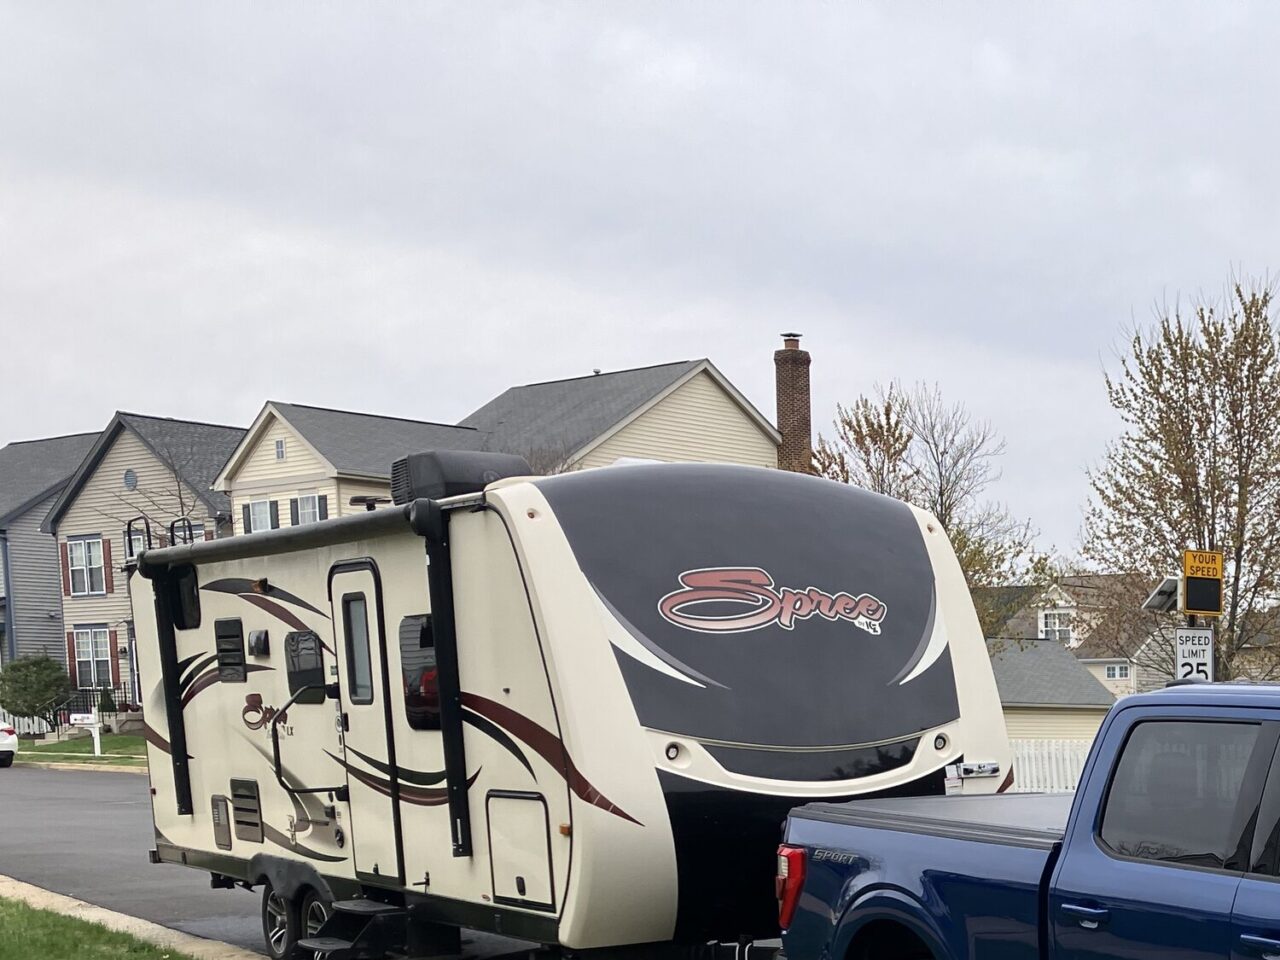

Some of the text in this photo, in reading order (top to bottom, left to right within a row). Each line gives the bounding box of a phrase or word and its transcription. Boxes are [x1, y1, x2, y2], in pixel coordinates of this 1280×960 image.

[1192, 554, 1217, 565] YOUR
[1190, 566, 1218, 577] SPEED
[658, 567, 887, 634] Spree
[1179, 635, 1210, 646] SPEED
[1182, 649, 1207, 659] LIMIT
[1181, 662, 1208, 681] 25
[813, 849, 859, 865] SPORT
